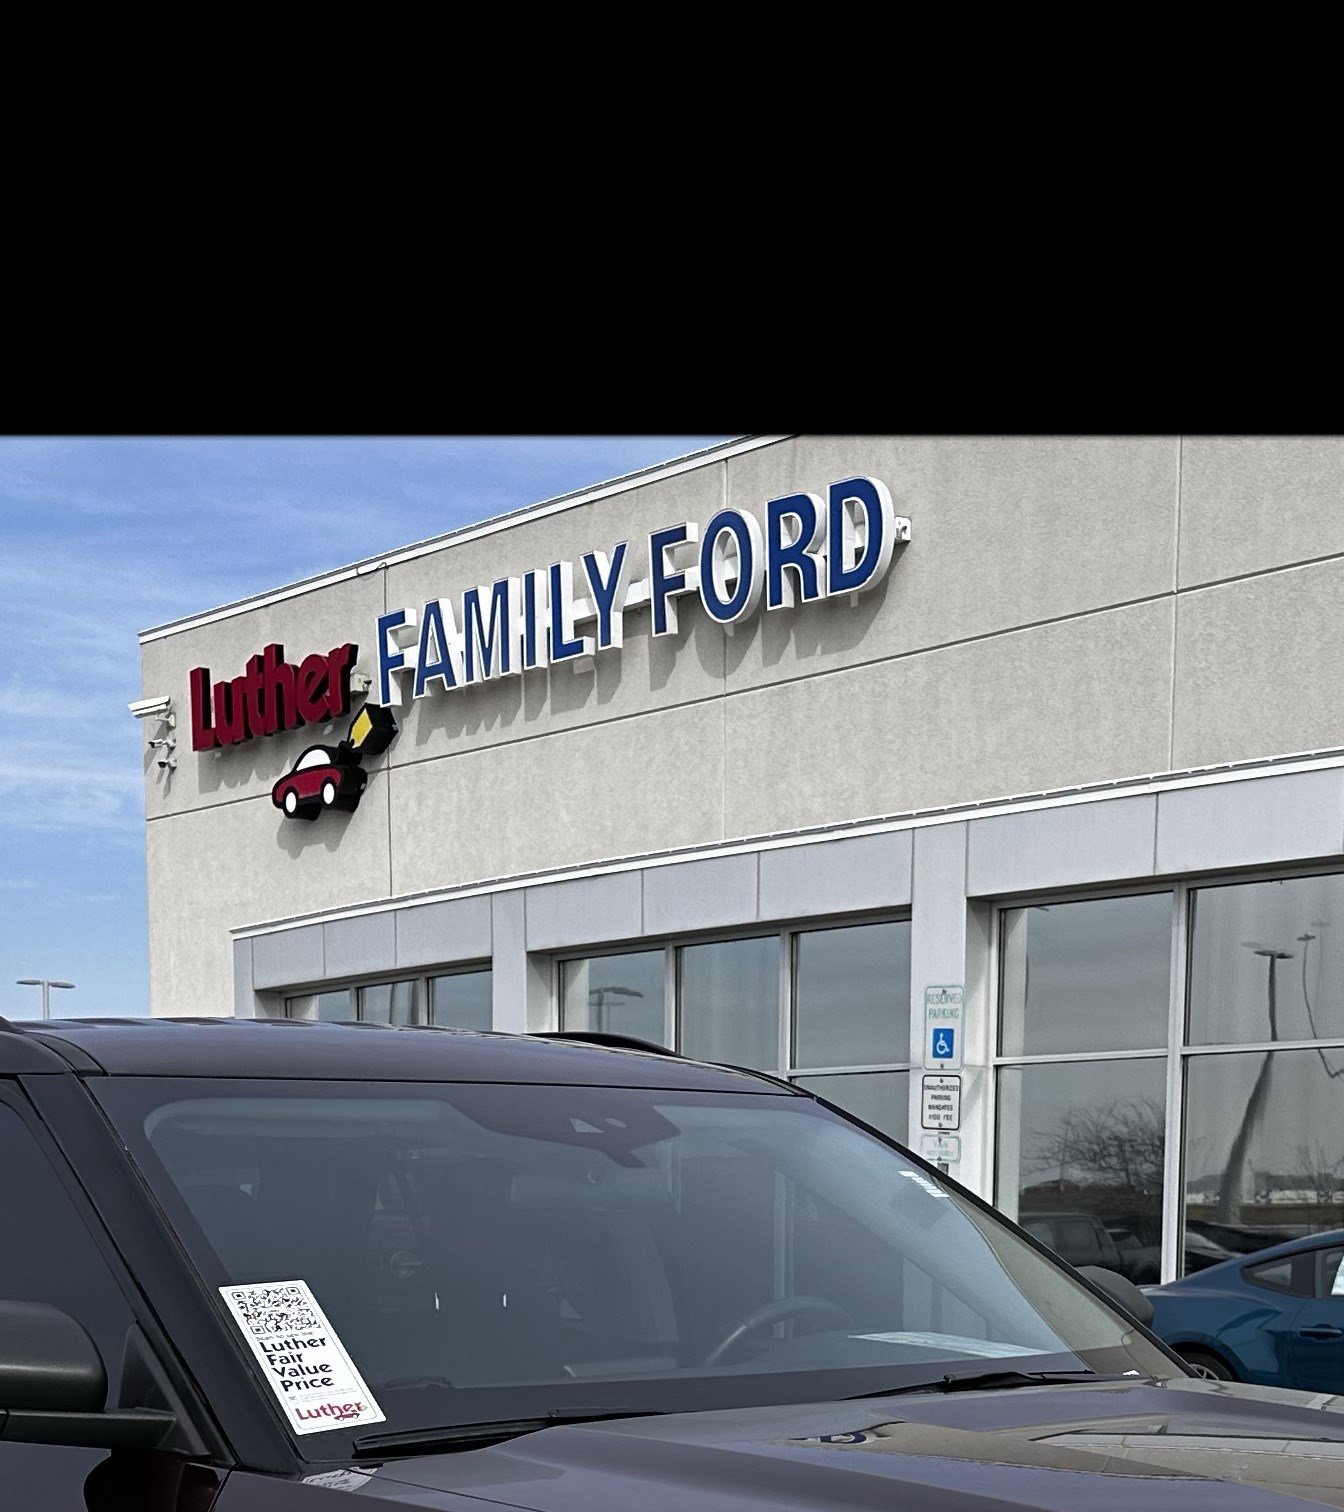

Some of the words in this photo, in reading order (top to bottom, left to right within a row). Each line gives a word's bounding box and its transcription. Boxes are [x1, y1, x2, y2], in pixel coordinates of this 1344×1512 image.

[376, 541, 630, 706] FAMILY
[651, 476, 890, 636] FORD
[190, 643, 359, 752] Luther
[259, 1337, 327, 1353] Luther
[266, 1352, 304, 1366] Fair
[271, 1364, 334, 1378] Value
[280, 1376, 335, 1392] Price
[295, 1401, 363, 1421] Luther
